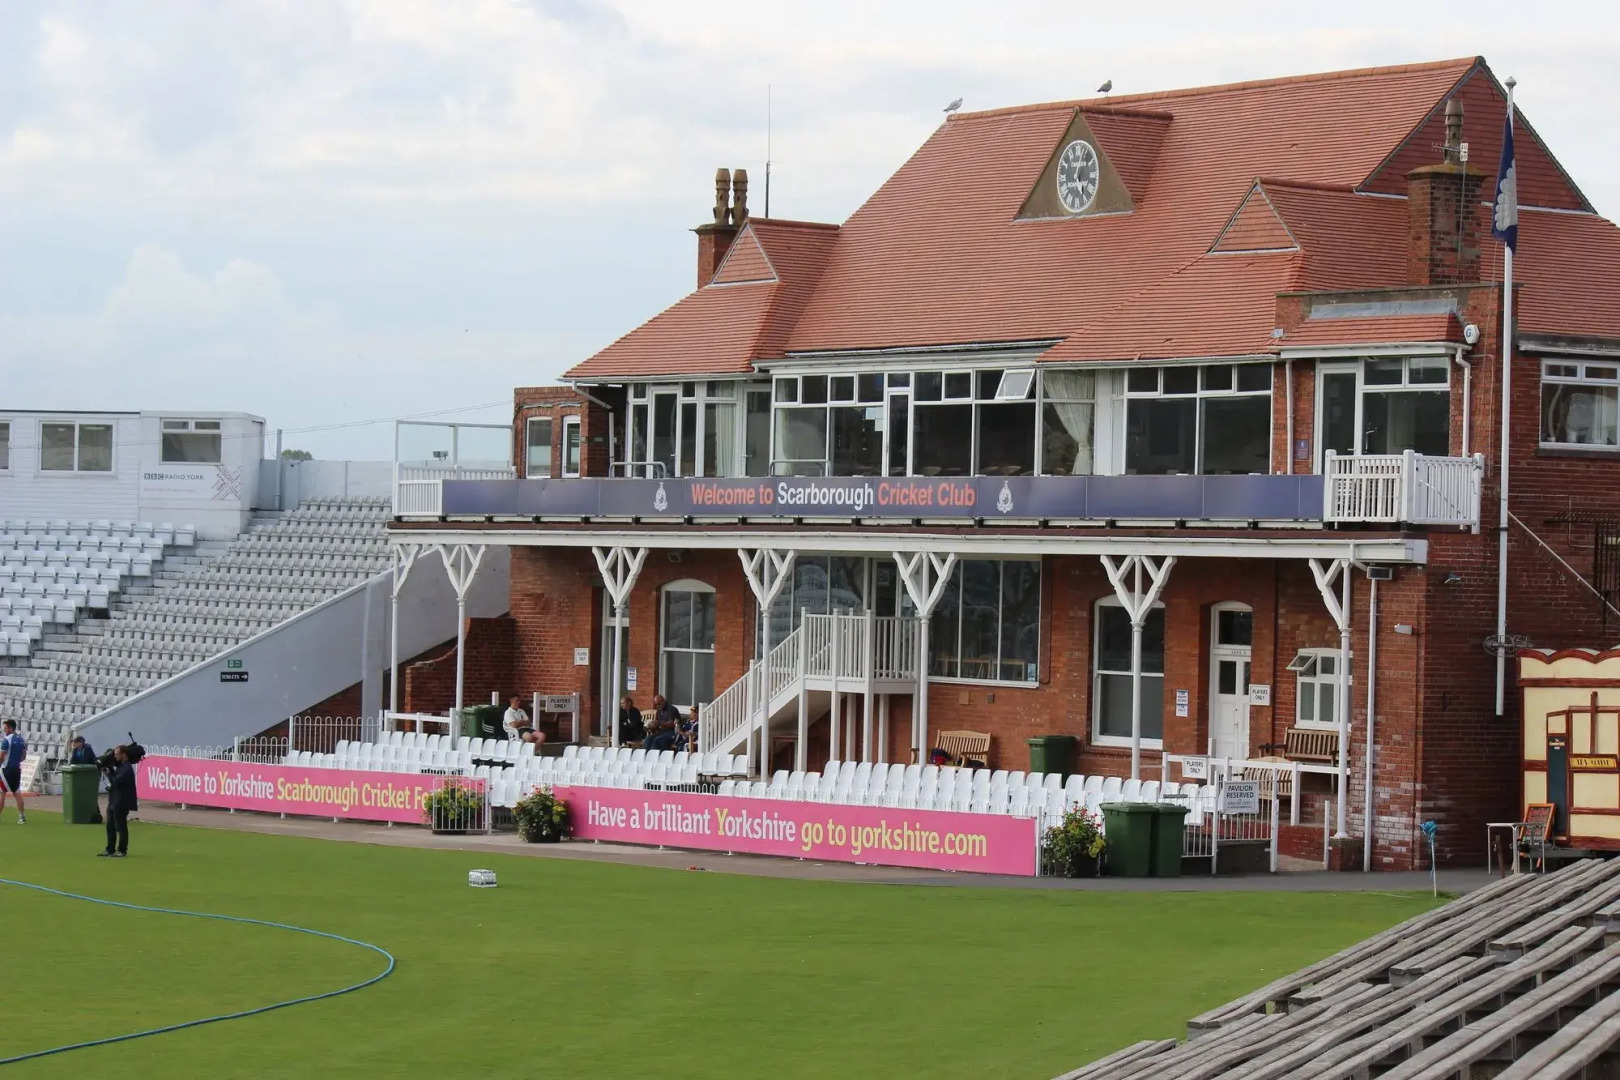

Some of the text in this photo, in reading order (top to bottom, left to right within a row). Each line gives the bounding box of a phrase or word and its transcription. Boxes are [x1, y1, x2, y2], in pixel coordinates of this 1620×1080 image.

[691, 481, 976, 512] Welcome to Scarborough Cricket Club
[1186, 760, 1204, 768] PLAYERS
[147, 766, 201, 793] Welcome
[204, 772, 217, 794] to
[218, 771, 274, 800] Yorkshire
[277, 777, 359, 812] Scarborough
[362, 783, 411, 810] Cricket
[1226, 791, 1255, 799] RESERVED
[588, 800, 987, 857] Have a brilliant Yorkshire go to yorkshire.com
